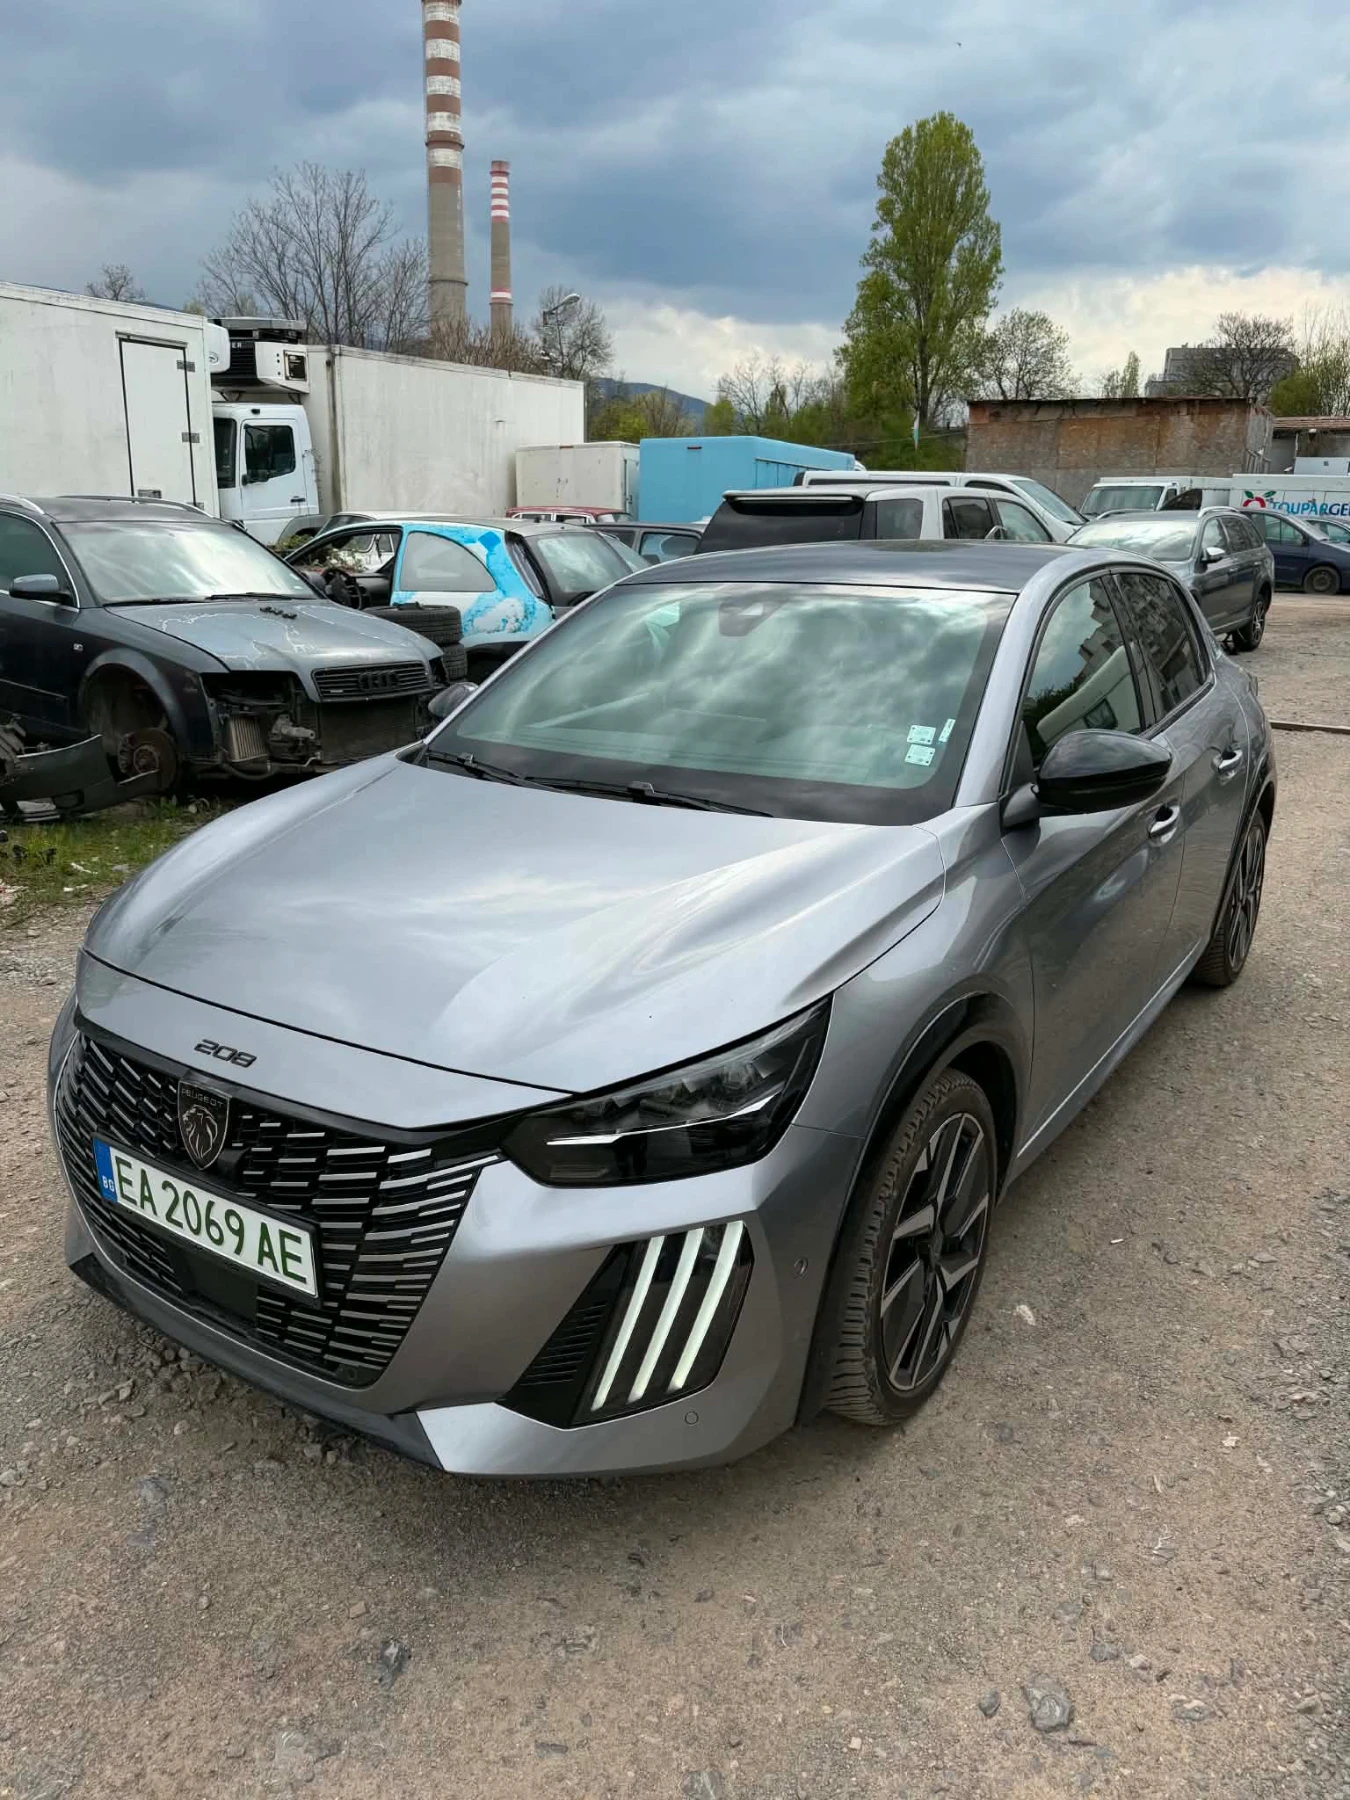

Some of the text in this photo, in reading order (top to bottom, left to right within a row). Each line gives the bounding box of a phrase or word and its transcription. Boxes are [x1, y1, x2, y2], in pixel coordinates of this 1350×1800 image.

[1271, 501, 1350, 517] TOUPARGE
[194, 1039, 257, 1068] 208
[181, 1088, 224, 1108] PEUGEOT
[102, 1174, 115, 1192] BG
[115, 1155, 307, 1285] EA 2069 AE
